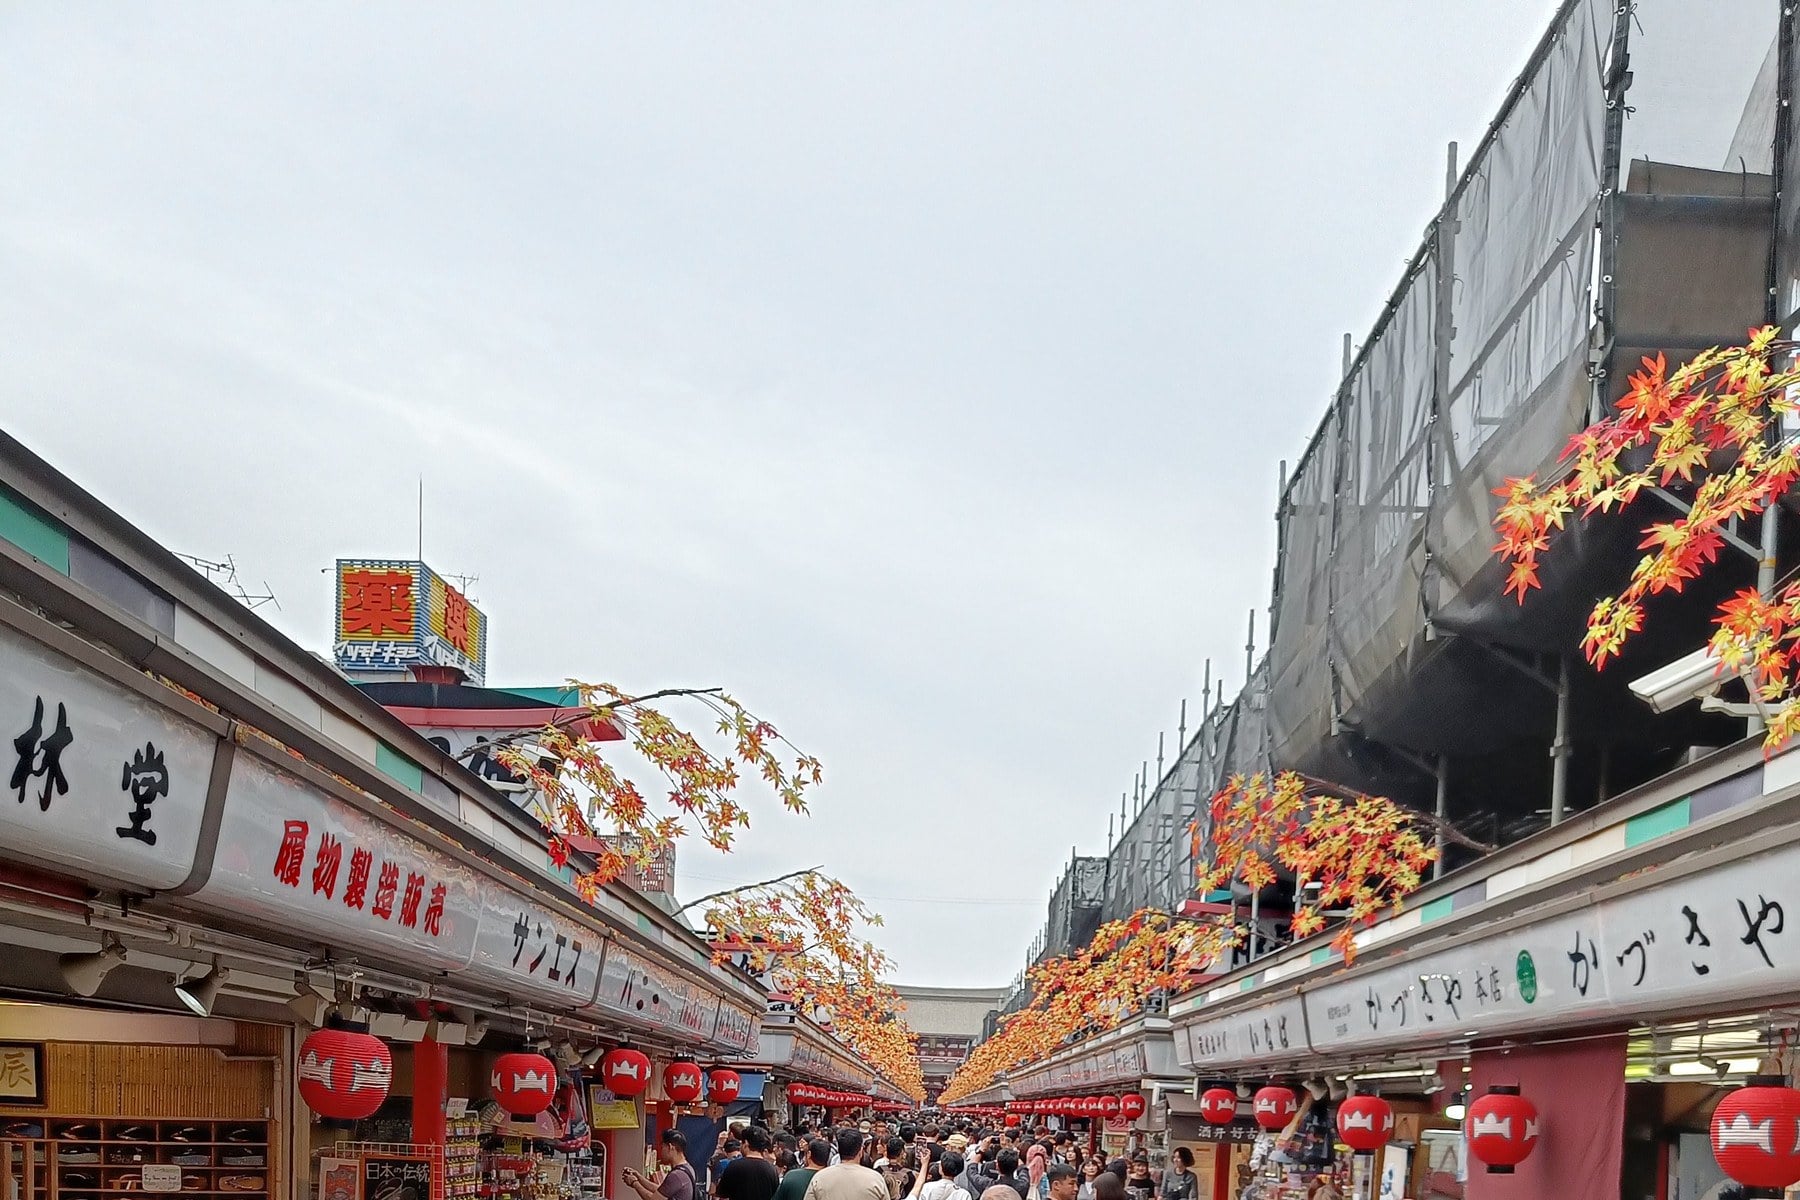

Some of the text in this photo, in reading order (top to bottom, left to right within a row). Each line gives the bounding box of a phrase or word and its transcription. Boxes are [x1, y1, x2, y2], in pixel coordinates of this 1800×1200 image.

[342, 569, 413, 636] 薬
[10, 695, 169, 846] 林堂
[273, 820, 447, 937] 履物製造販売
[512, 912, 582, 989] サンエス
[1567, 894, 1785, 997] かづさや
[366, 1162, 430, 1184] 日本の伝統
